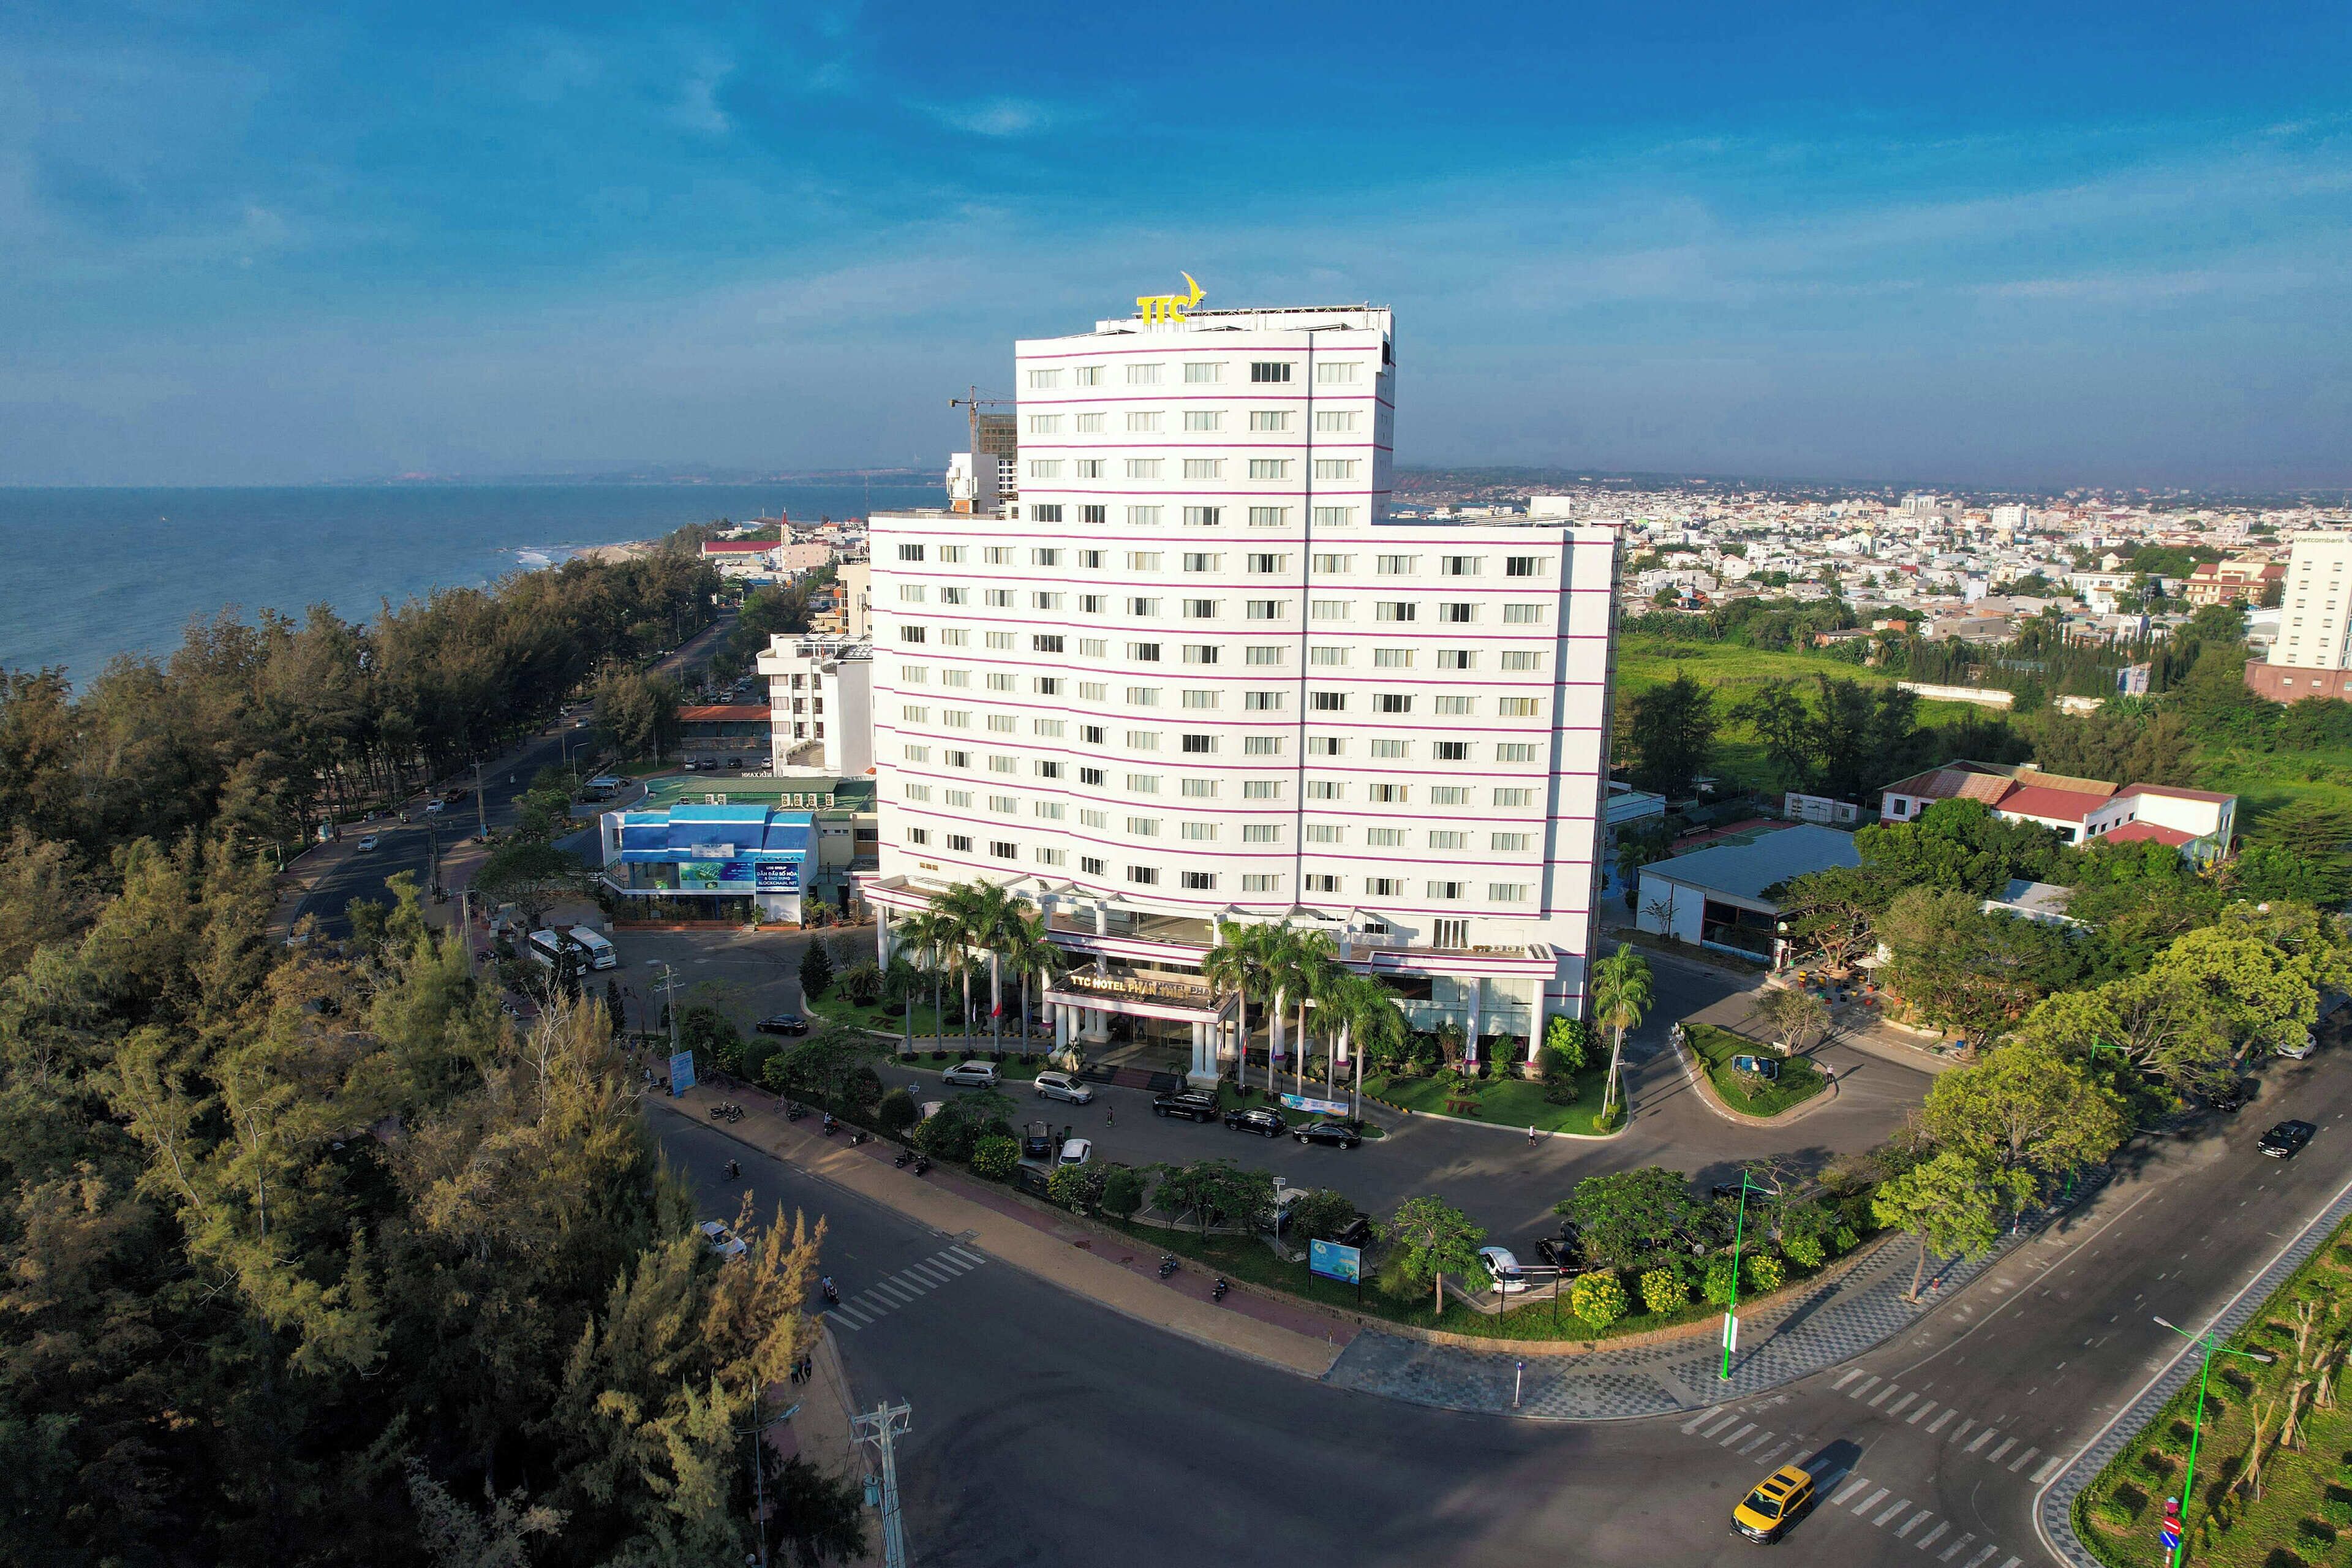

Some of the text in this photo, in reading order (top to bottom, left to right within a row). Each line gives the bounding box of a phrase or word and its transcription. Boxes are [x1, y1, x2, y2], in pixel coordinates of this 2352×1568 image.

[1137, 295, 1190, 325] TTC
[1071, 975, 1091, 987] TTC
[1093, 978, 1126, 992] HOTEL
[1128, 983, 1156, 995] PHAN
[1444, 1099, 1482, 1117] TTC
